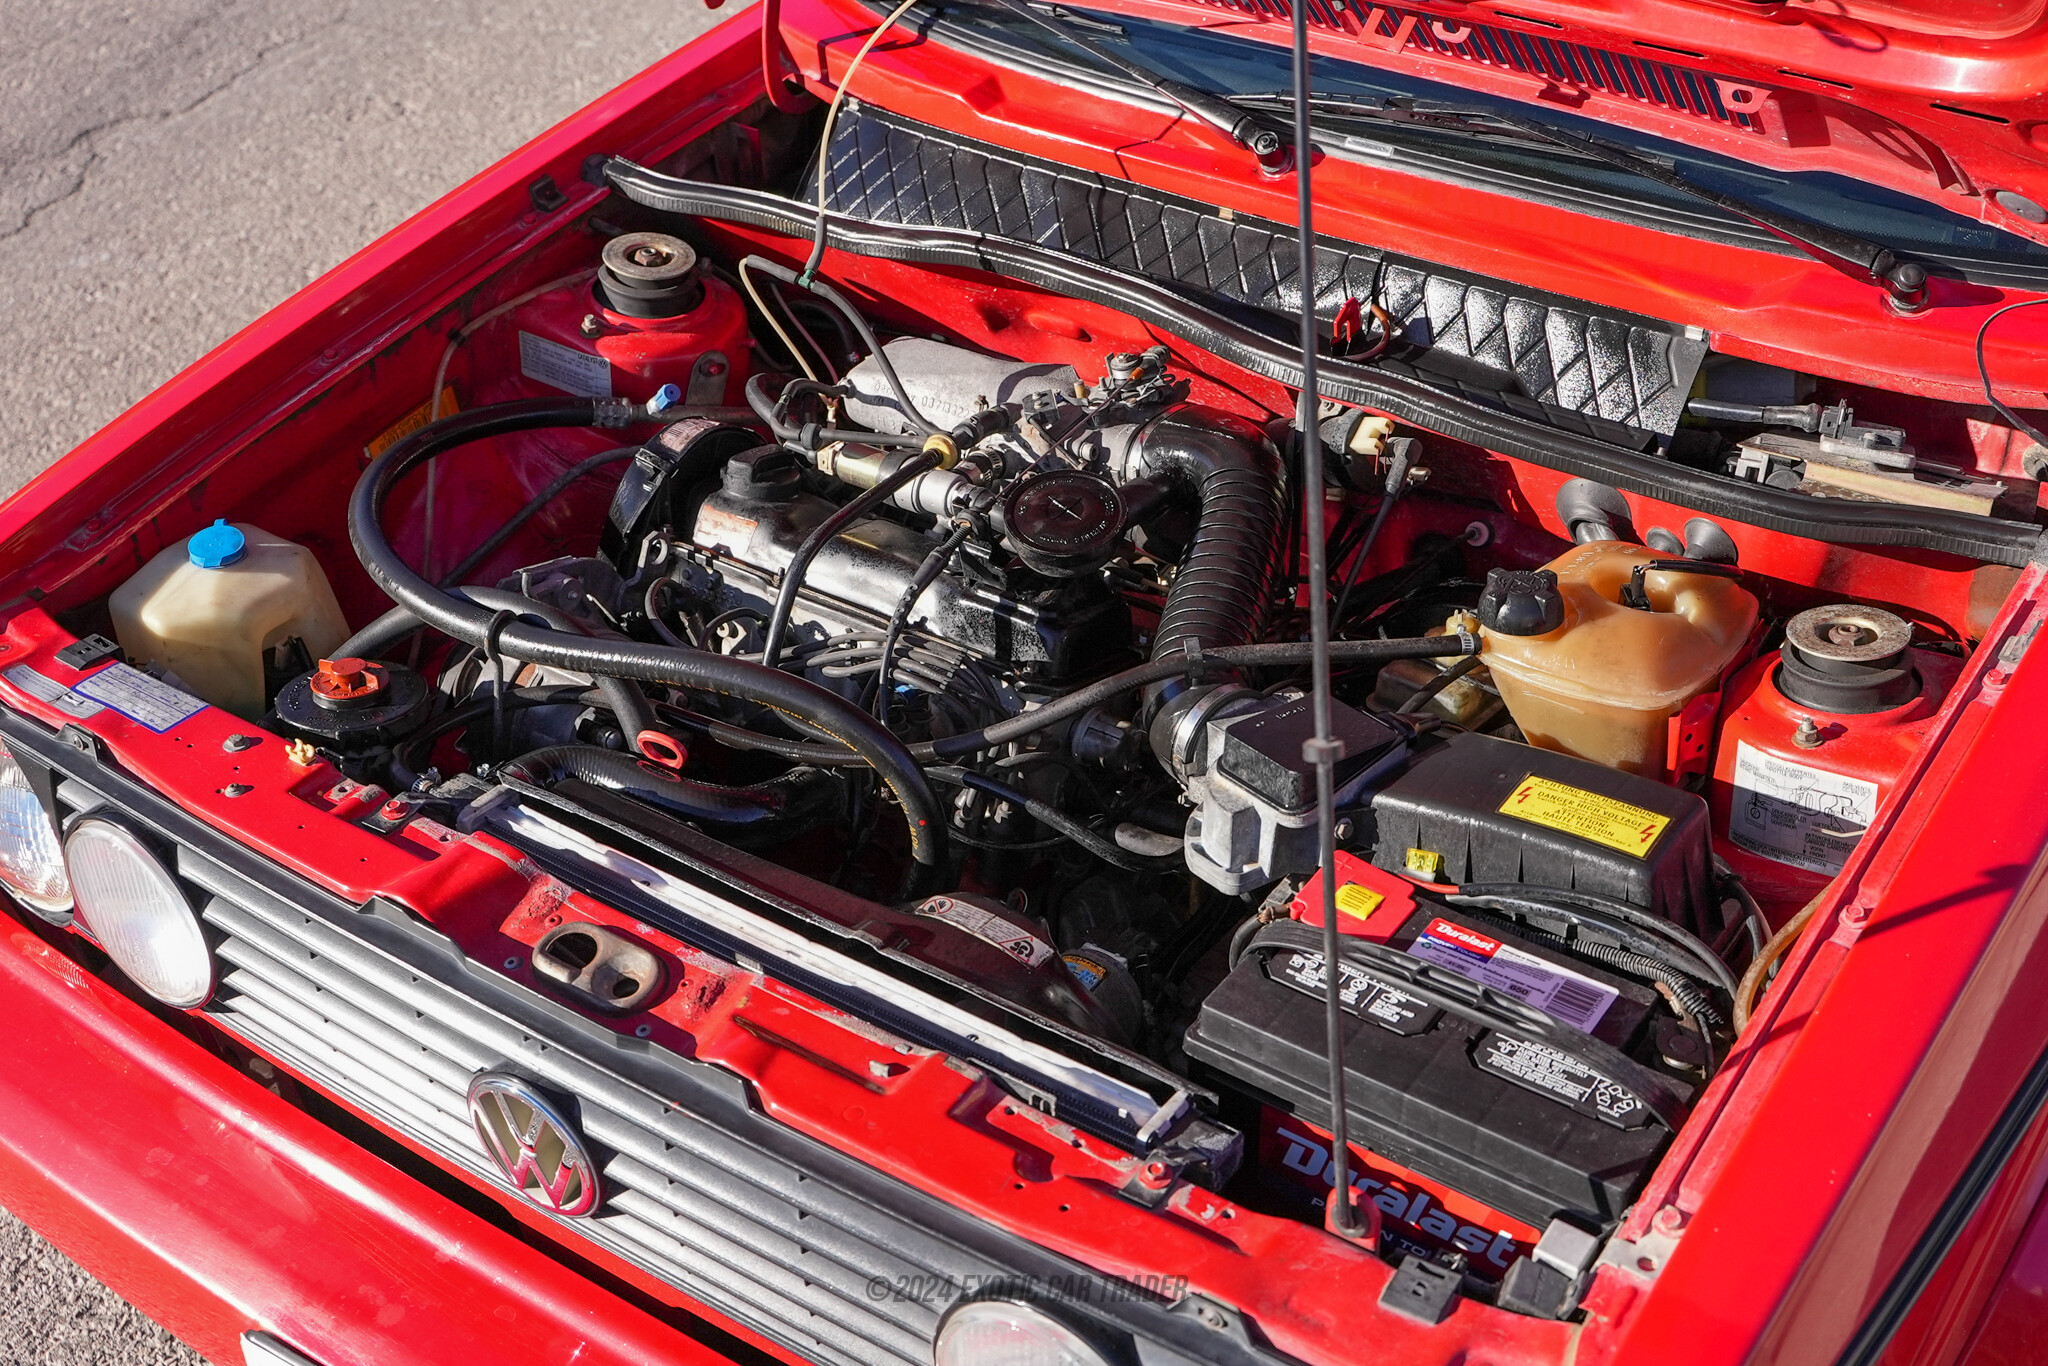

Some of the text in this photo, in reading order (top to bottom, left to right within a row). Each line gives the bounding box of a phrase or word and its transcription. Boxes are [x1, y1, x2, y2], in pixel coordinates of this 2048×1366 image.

[1537, 790, 1644, 827] DANGER HIGH VOLTAGE
[1538, 779, 1660, 819] ACHTUNG HOCHSPANNUNG
[1541, 810, 1573, 824] HAUTE
[1574, 820, 1615, 837] TENSION
[1554, 808, 1609, 829] ATTENTION!
[1436, 922, 1496, 951] Duralast
[1509, 984, 1529, 994] 650
[1277, 1127, 1516, 1268] Duralast
